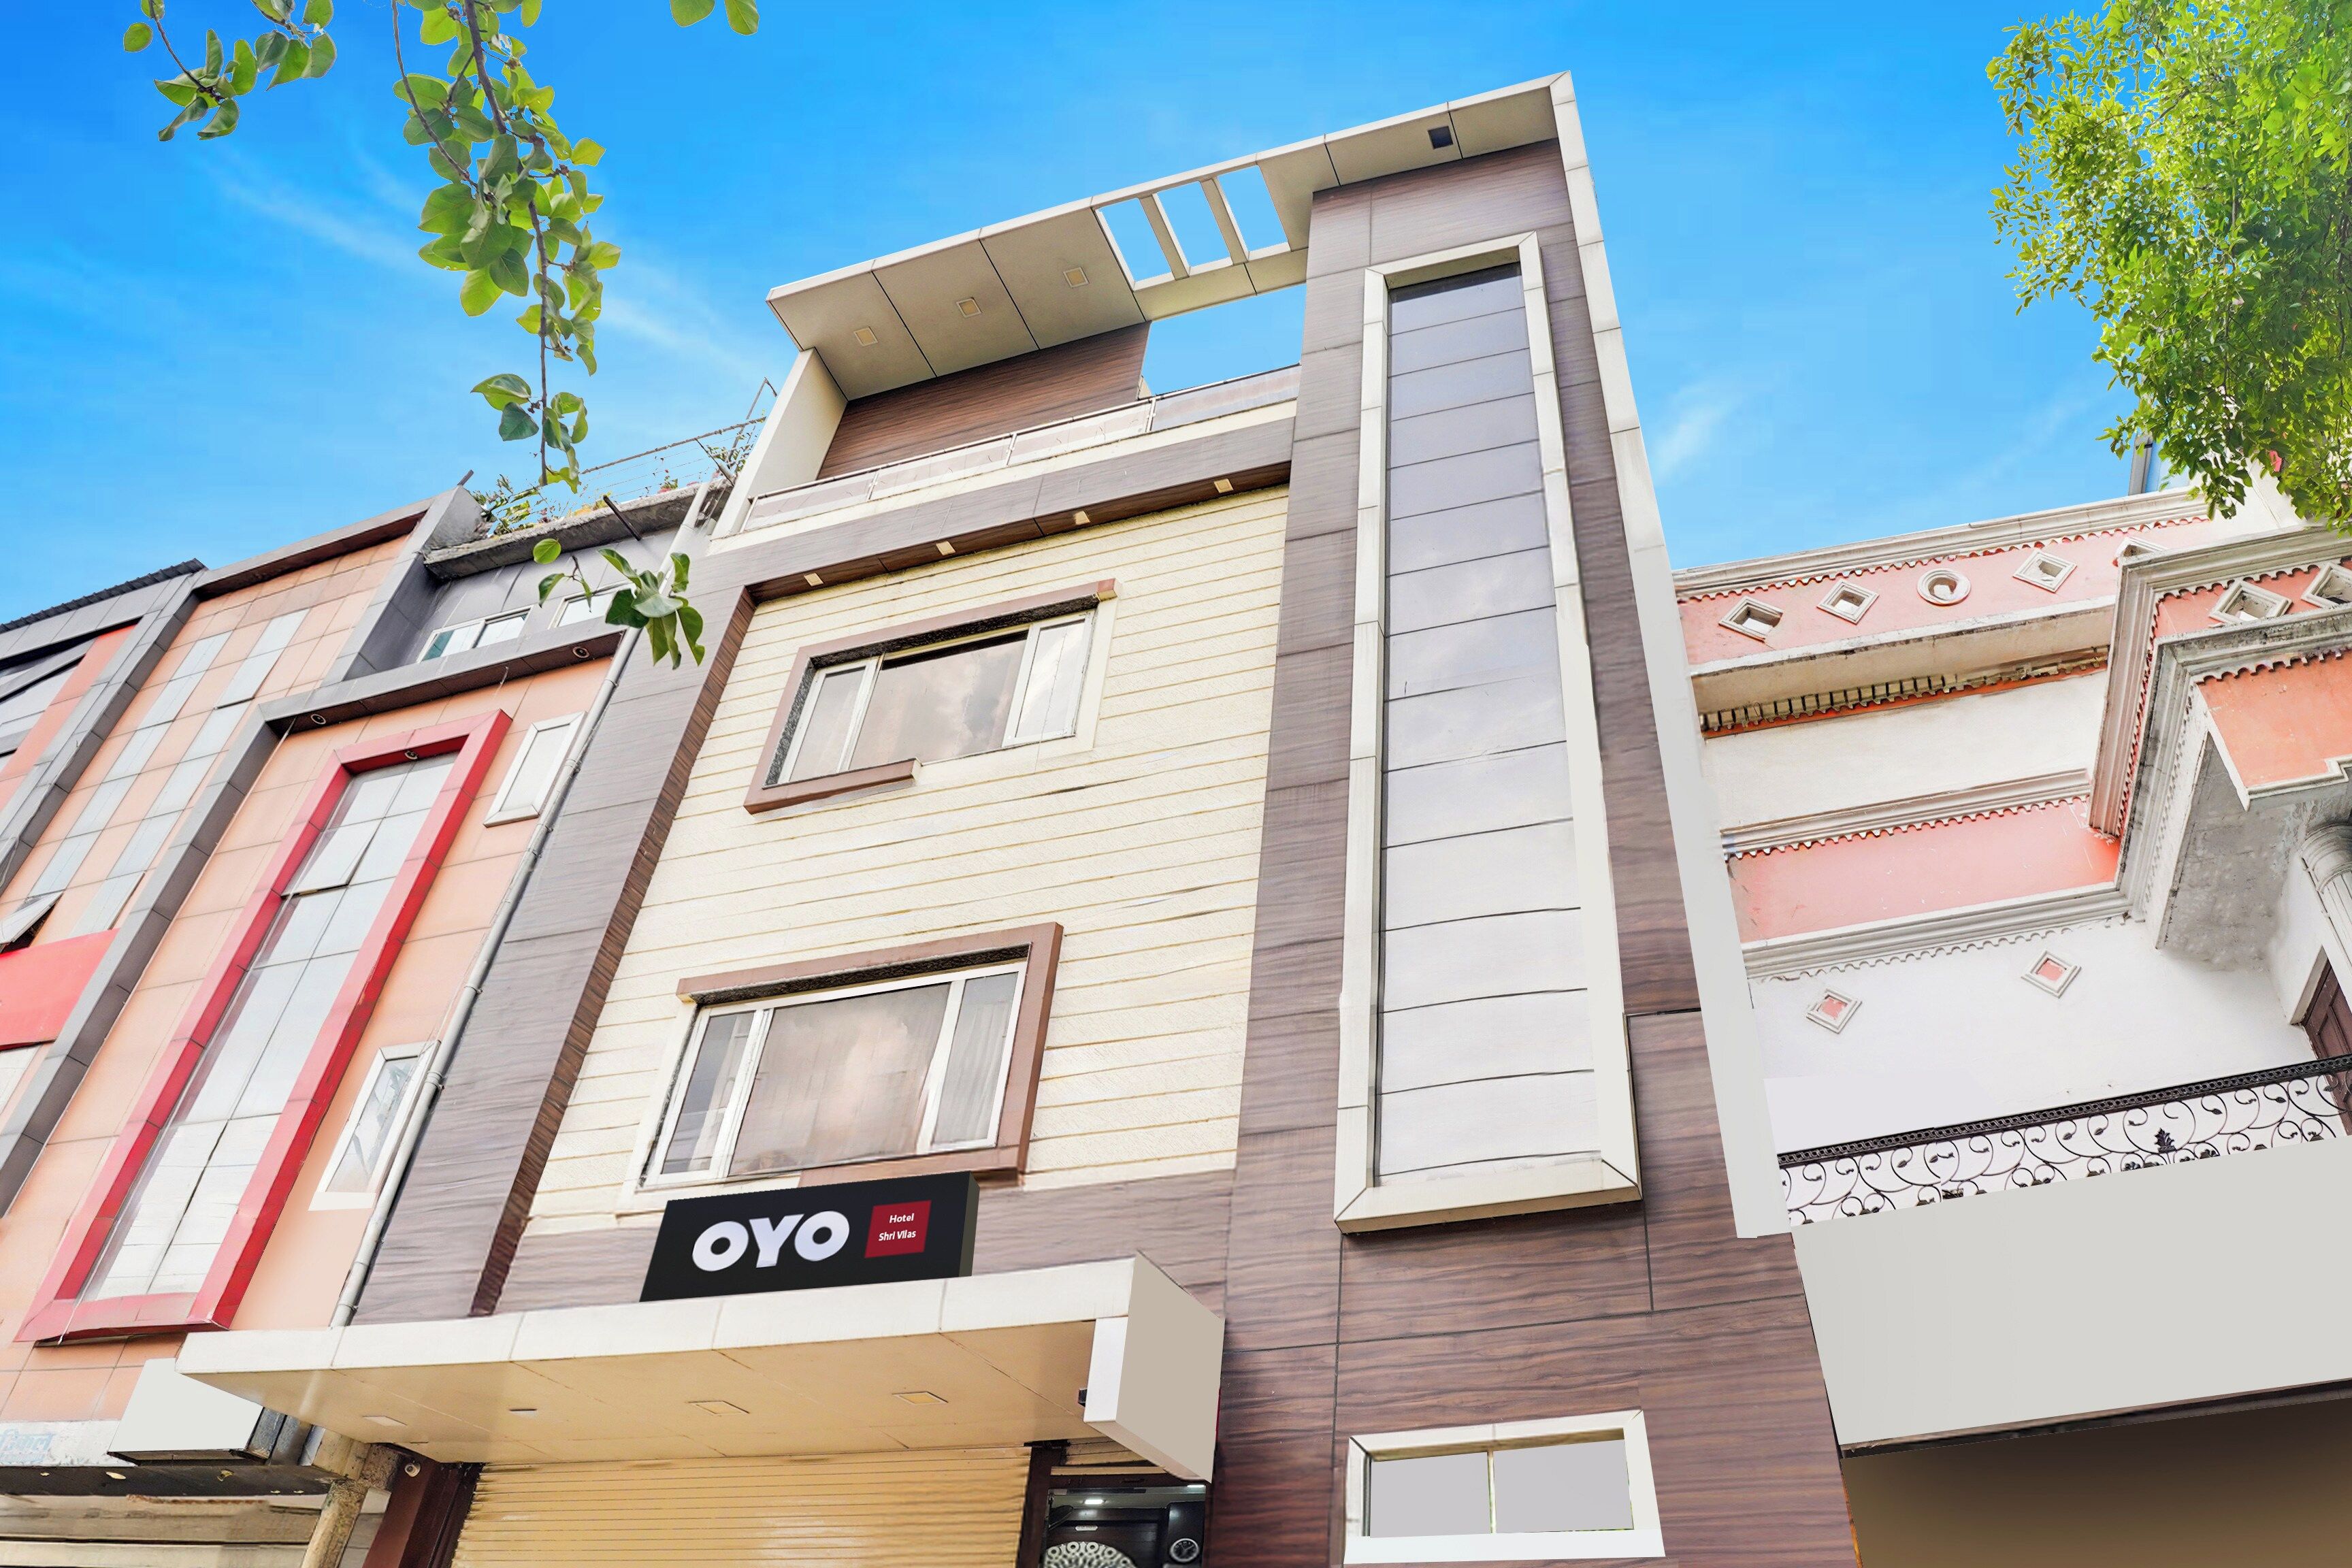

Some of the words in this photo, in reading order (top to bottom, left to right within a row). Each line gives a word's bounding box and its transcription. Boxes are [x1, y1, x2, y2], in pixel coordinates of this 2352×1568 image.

[889, 1213, 915, 1224] Hotel
[878, 1230, 896, 1241] Shri
[896, 1229, 917, 1239] Vilas
[692, 1211, 850, 1272] OYO
